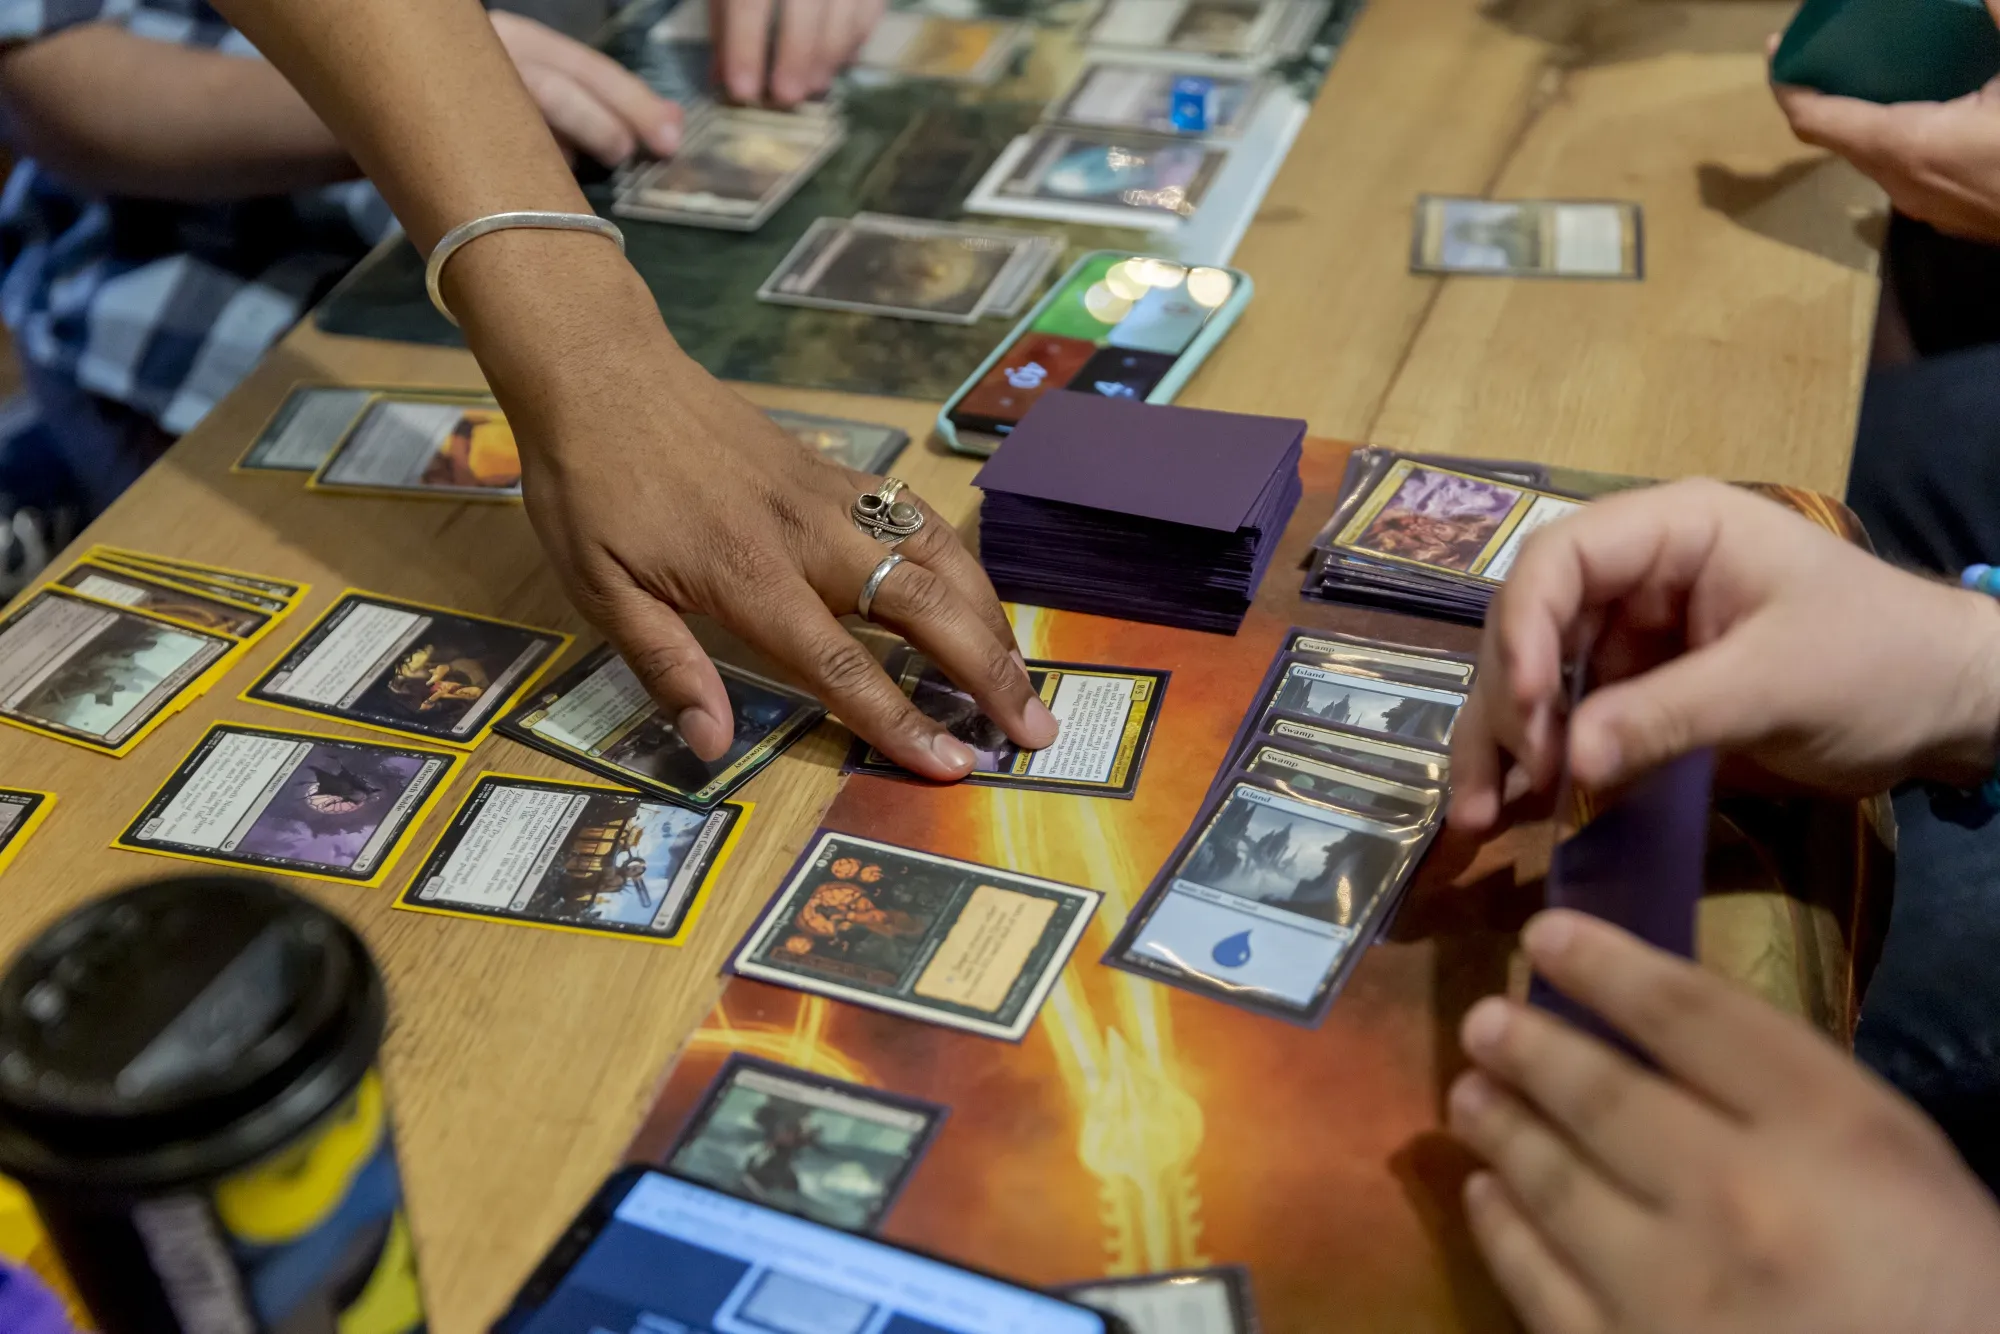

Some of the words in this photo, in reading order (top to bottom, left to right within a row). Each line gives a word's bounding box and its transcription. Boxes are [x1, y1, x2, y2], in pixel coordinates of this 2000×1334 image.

[1303, 641, 1335, 654] Swamp
[1296, 668, 1325, 679] Island
[1134, 683, 1146, 695] 5/8
[1281, 725, 1315, 739] Swamp
[731, 742, 768, 770] Stowaway
[1265, 751, 1299, 769] Swamp
[407, 761, 438, 793] Falkenrath
[393, 793, 414, 812] Noble
[1241, 788, 1271, 804] Island
[566, 796, 586, 818] Creature
[142, 823, 158, 834] 2/2
[700, 812, 725, 839] Zulaport
[549, 825, 568, 845] Human
[683, 839, 708, 870] Cutthroat
[530, 864, 545, 876] Ally
